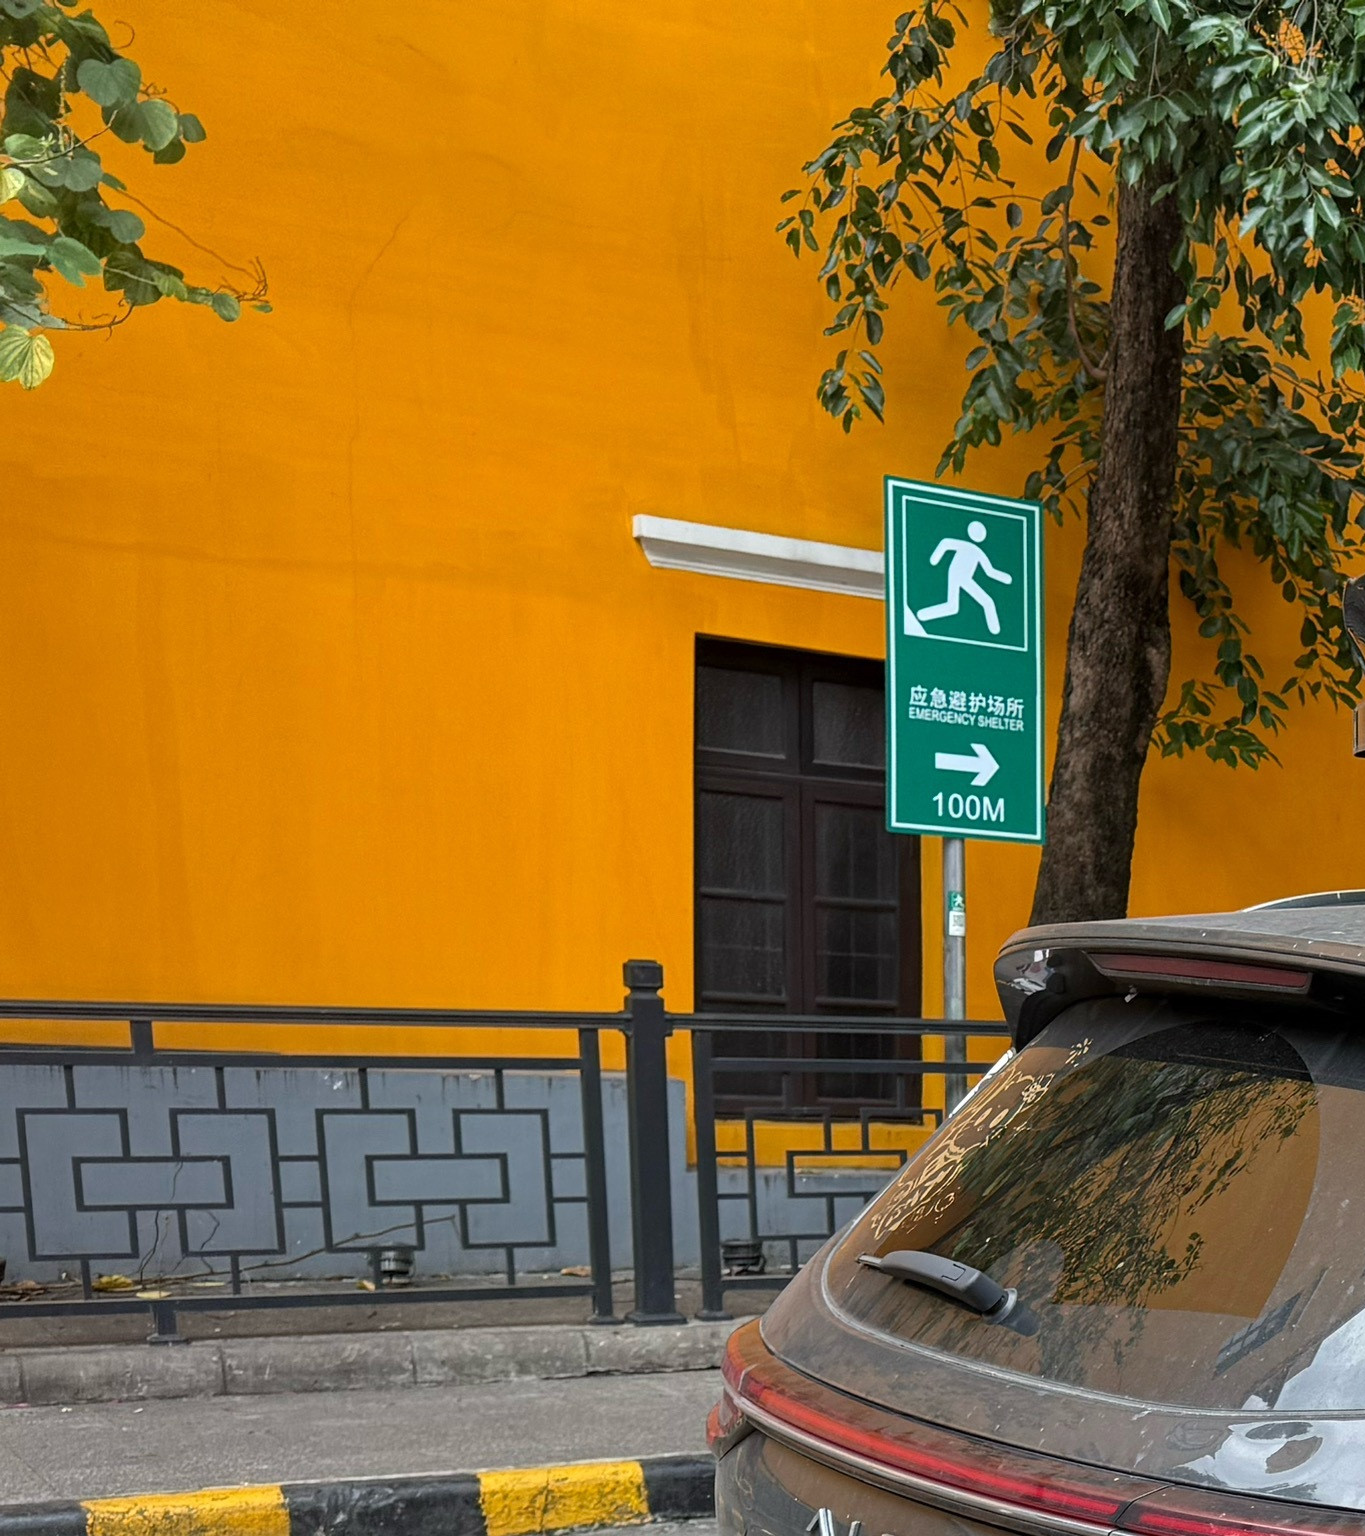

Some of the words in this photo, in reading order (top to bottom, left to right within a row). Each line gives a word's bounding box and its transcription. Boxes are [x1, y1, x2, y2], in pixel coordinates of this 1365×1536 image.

[909, 684, 1025, 719] 应急避护场所
[908, 706, 976, 727] EMERGENCY
[977, 714, 1025, 732] SHELTER
[931, 791, 1006, 823] 100M
